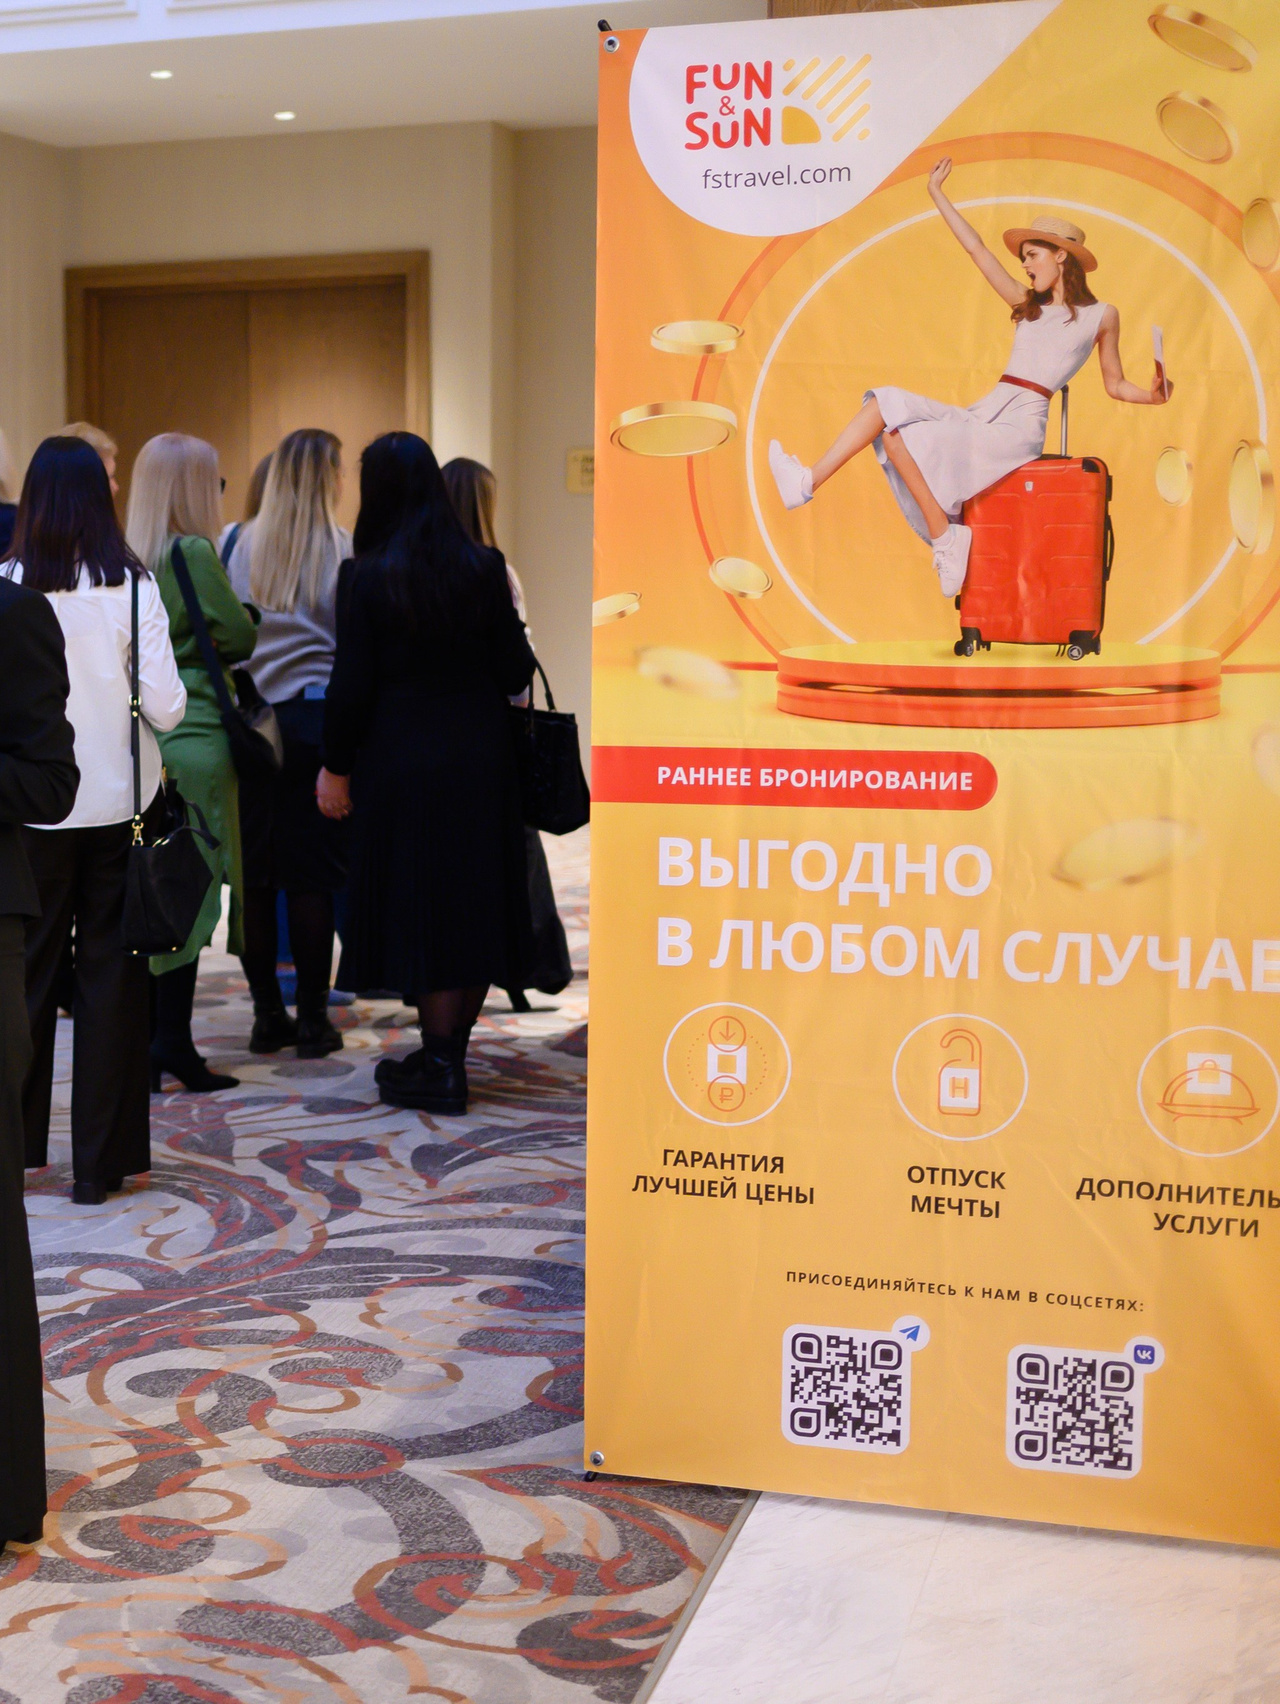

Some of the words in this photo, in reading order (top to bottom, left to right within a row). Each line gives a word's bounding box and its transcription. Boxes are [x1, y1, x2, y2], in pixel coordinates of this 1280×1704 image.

[686, 60, 773, 104] FUN
[719, 95, 735, 116] &
[684, 107, 772, 150] SUN
[702, 164, 851, 189] fstravel.com
[657, 766, 752, 788] РАННЕЕ
[759, 767, 973, 792] БРОНИРОВАНИЕ
[658, 837, 992, 907] ВЫГОДНО
[657, 917, 693, 966] В
[709, 919, 980, 980] ЛЮБОМ
[1002, 930, 1280, 993] СЛУЧАЕ
[662, 1149, 785, 1174] ГАРАНТИЯ
[632, 1174, 738, 1200] ЛУЧШЕЙ
[745, 1183, 815, 1205] ЦЕНЫ
[906, 1165, 1006, 1190] ОТПУСК
[911, 1194, 1001, 1219] МЕЧТЫ
[1153, 1212, 1260, 1238] УСЛУГИ
[786, 1271, 957, 1296] ПРИСОЕДИНЯЙТЕСЬ
[965, 1286, 975, 1298] К
[982, 1288, 1021, 1301] НАМ
[1029, 1291, 1038, 1303] В
[1046, 1293, 1144, 1312] СОЦСЕТЯХ:
